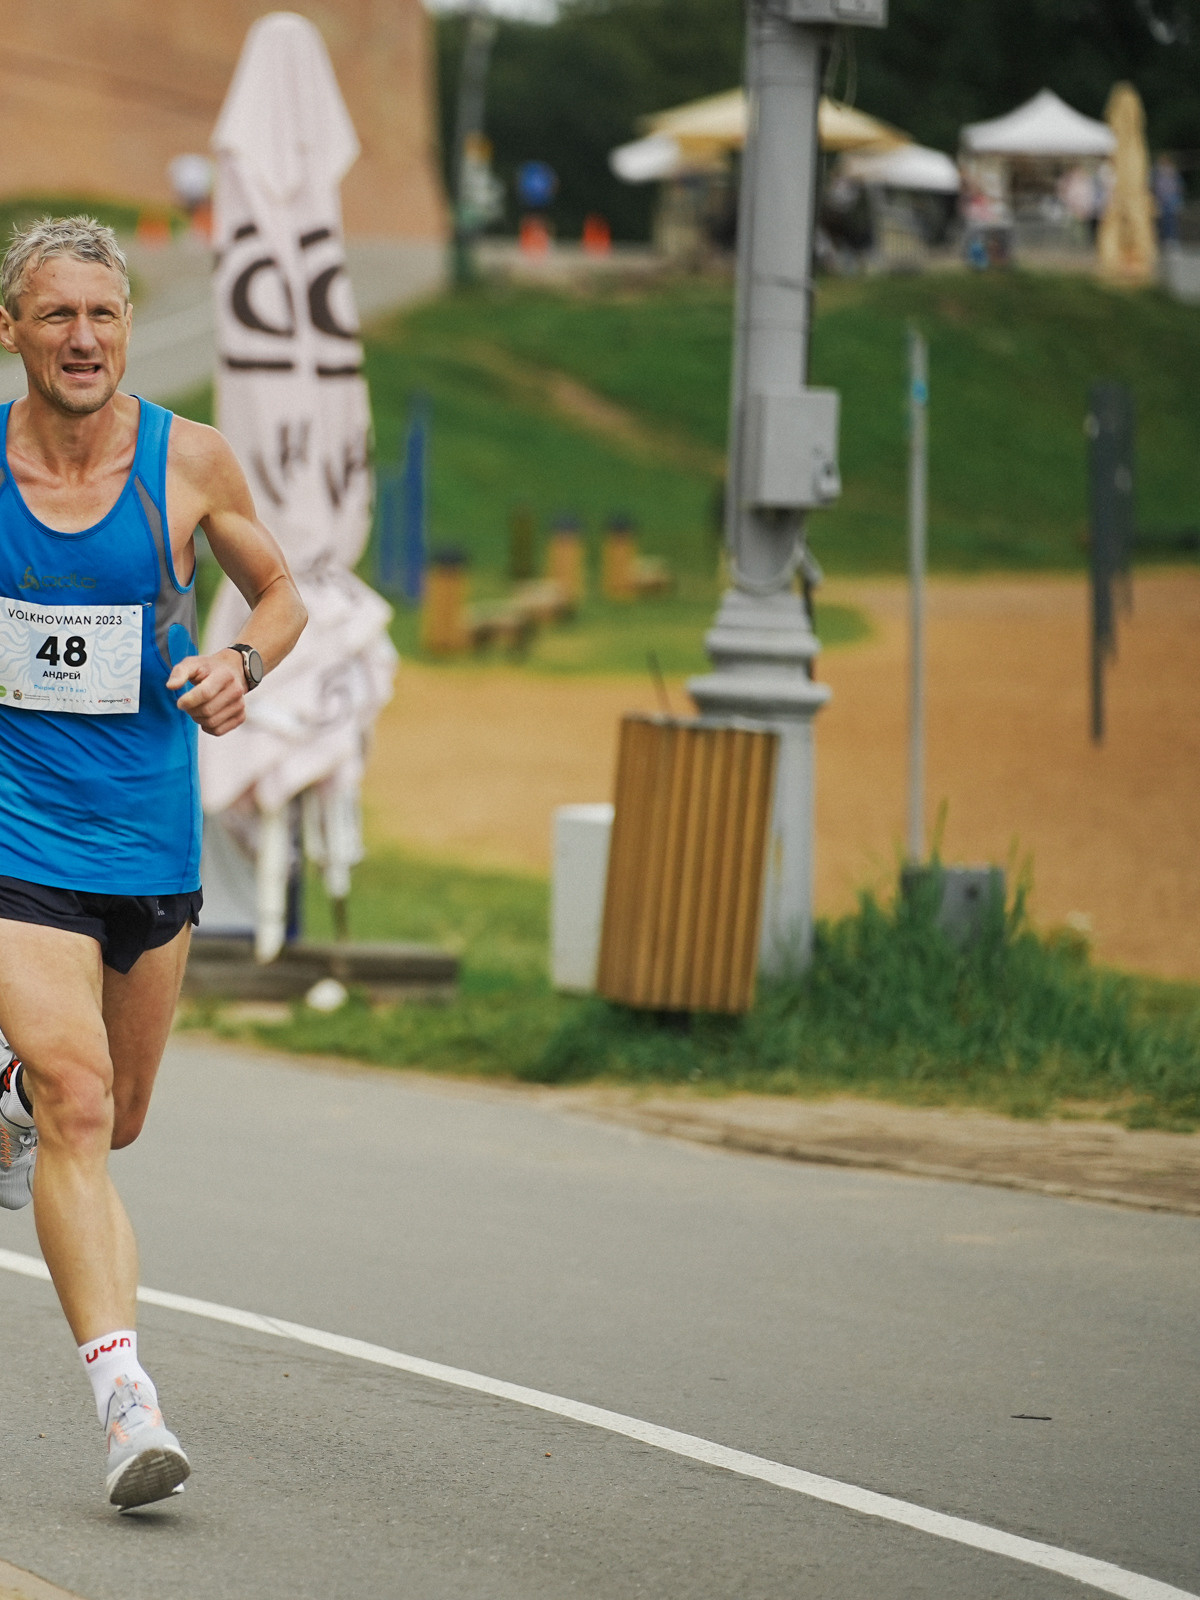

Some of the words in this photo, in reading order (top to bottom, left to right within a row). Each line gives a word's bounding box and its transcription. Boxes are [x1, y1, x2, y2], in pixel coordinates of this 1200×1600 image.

[8, 608, 92, 625] VOLKHOVMAN
[95, 615, 123, 625] 2023
[35, 635, 88, 668] 48
[42, 670, 81, 681] АНДРЕЙ
